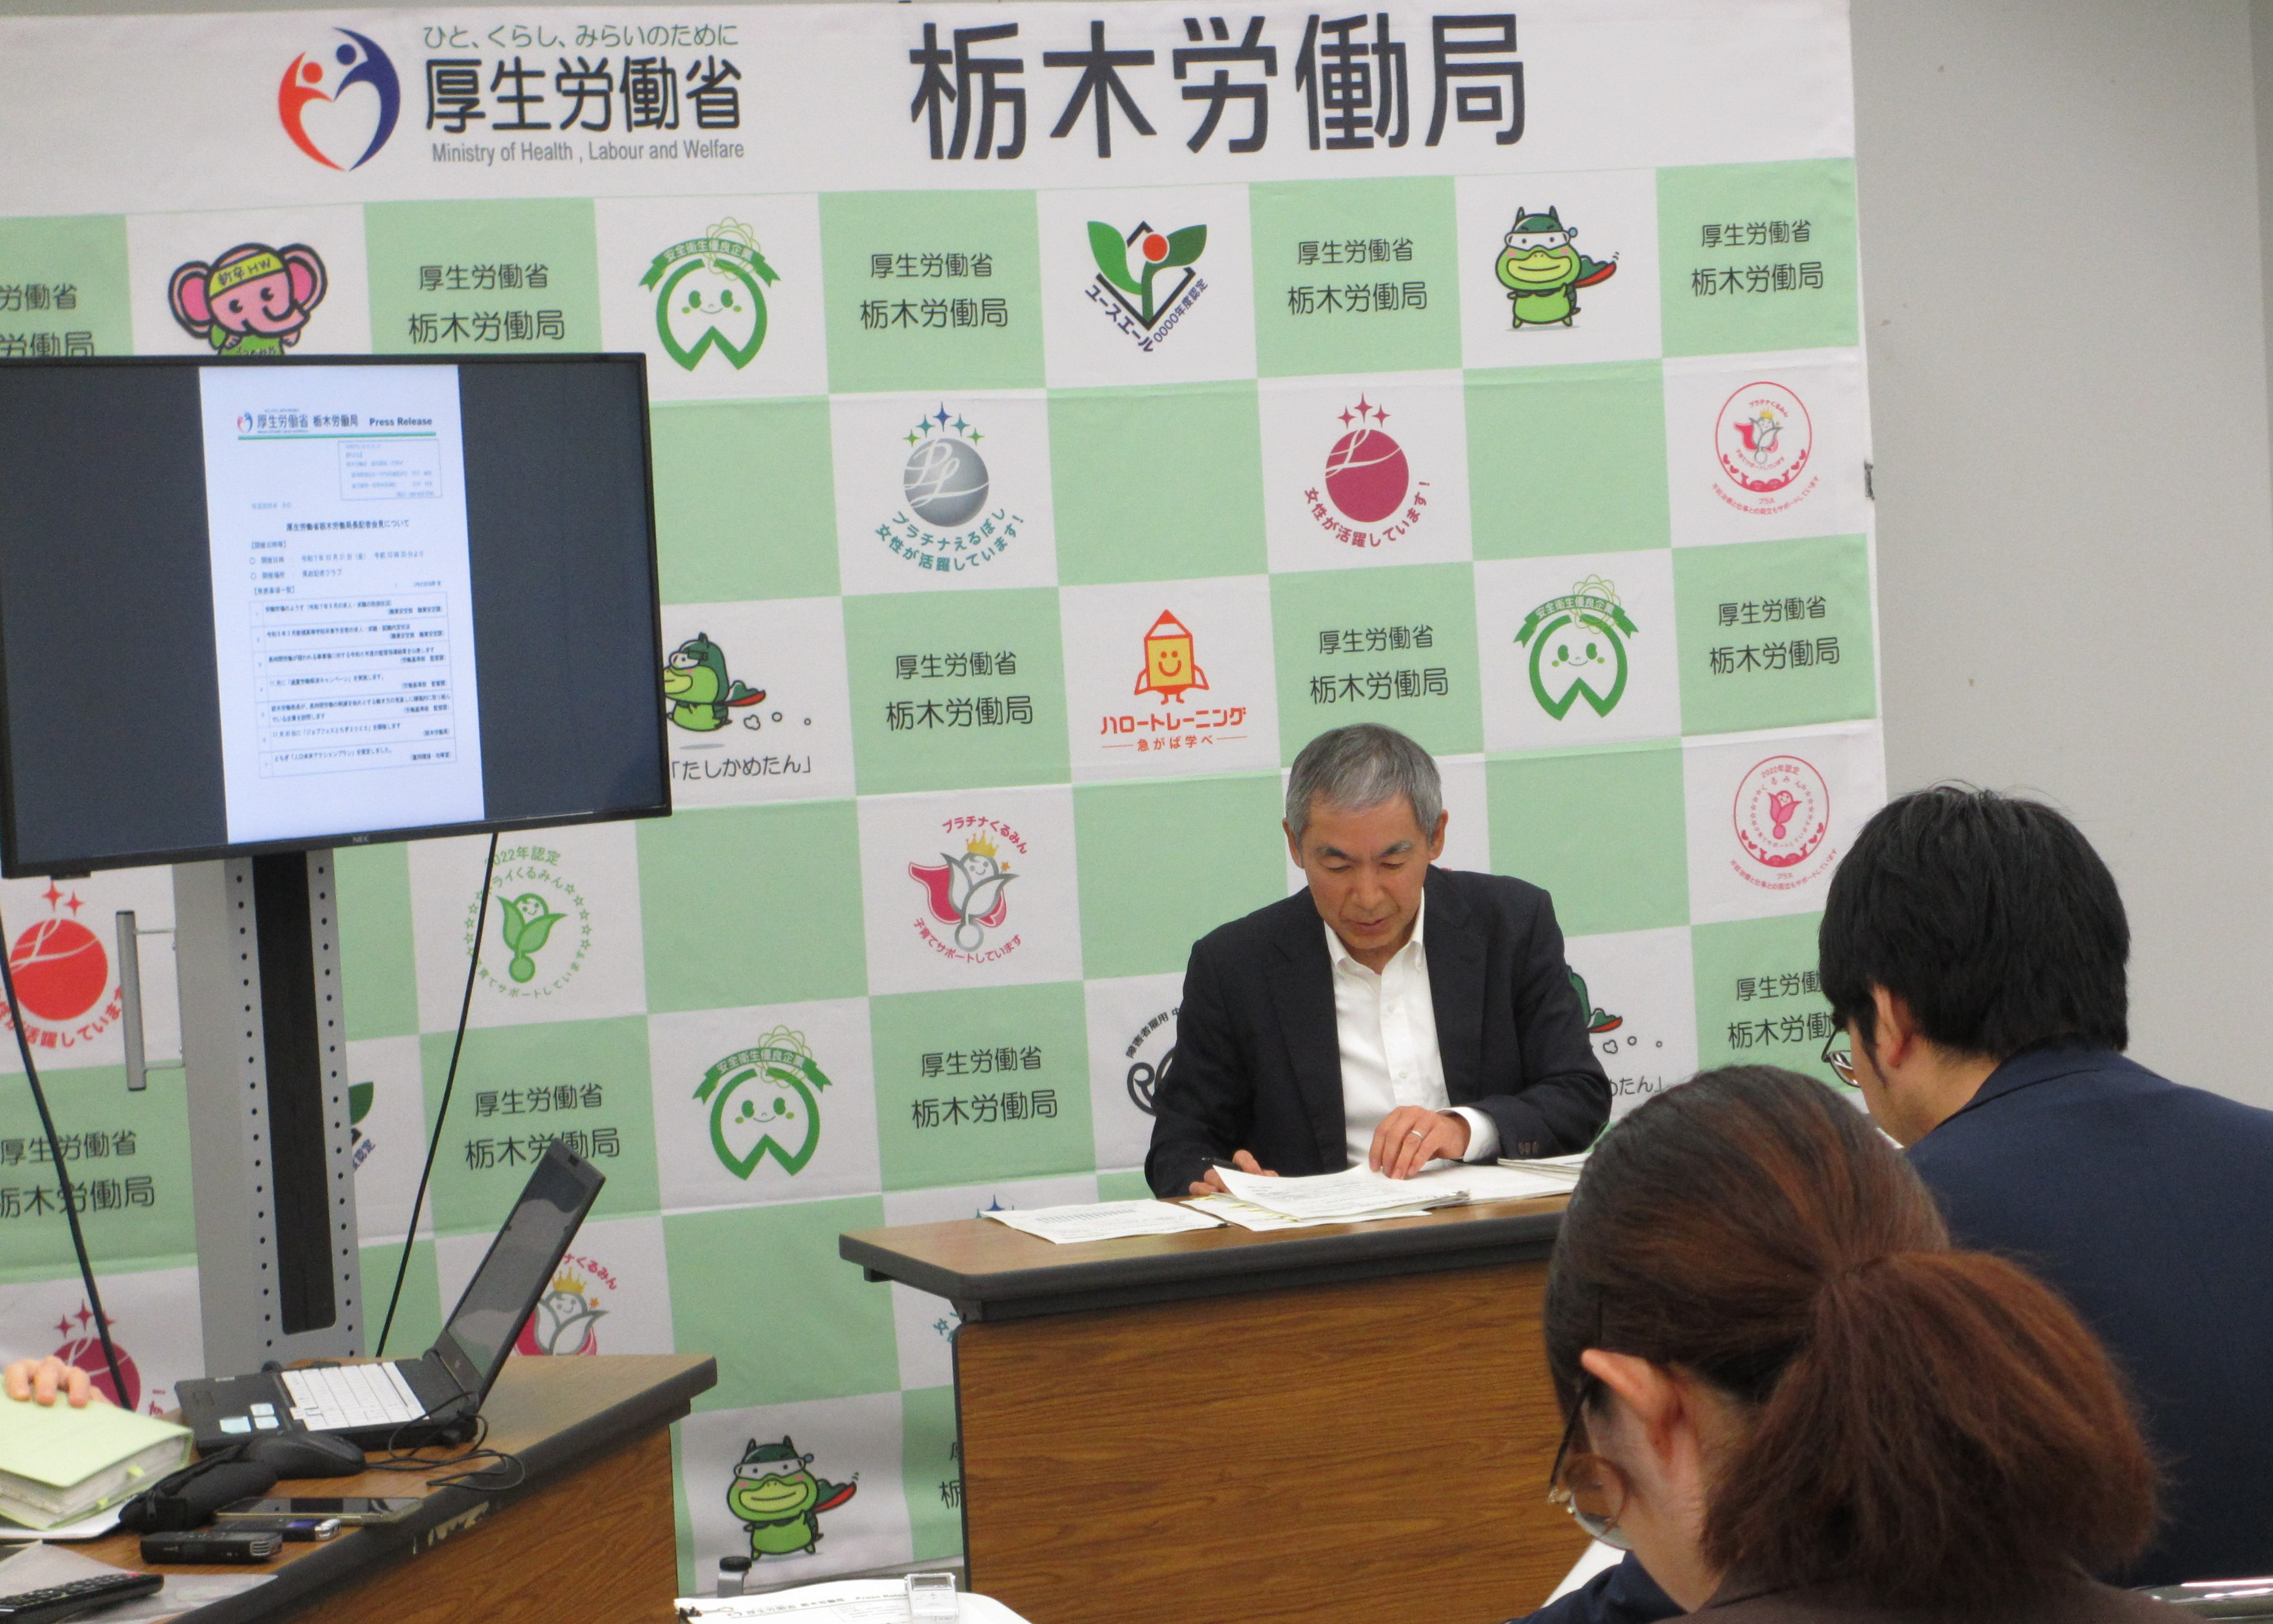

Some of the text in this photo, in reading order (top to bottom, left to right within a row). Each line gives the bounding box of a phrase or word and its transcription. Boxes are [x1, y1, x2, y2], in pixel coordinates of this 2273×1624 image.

[423, 24, 739, 49] ひと、くらし、みらいのために
[425, 56, 742, 134] 厚生労働省
[909, 12, 1525, 161] 栃木労働局
[432, 141, 495, 165] Ministry
[500, 141, 516, 162] of
[520, 141, 573, 162] Health
[588, 140, 644, 161] Labour
[649, 140, 678, 160] and
[683, 139, 744, 159] Welfare
[1701, 220, 1812, 248] 厚生労働省
[870, 253, 994, 280] 厚生労働省
[1297, 239, 1414, 266] 厚生労働省
[419, 264, 550, 291] 厚生労働省
[1691, 261, 1824, 297] 栃木労働局
[860, 298, 1009, 330] 栃木労働局
[1288, 282, 1427, 315] 栃木労働局
[408, 310, 564, 345] 栃木労働局
[1085, 284, 1154, 352] ユースエール
[257, 414, 308, 429] 厚生労働省
[369, 417, 395, 426] Press
[397, 417, 433, 426] Release
[892, 508, 1006, 552] プラチナえるぼし
[1718, 595, 1826, 627] 厚生労働省
[1319, 624, 1434, 656] 厚生労働省
[1709, 636, 1840, 675] 栃木労働局
[895, 651, 1017, 680] 厚生労働省
[1310, 667, 1448, 704] 栃木労働局
[886, 696, 1033, 731] 栃木労働局
[1101, 706, 1247, 736] ハロートレーニング
[1137, 734, 1215, 752] 急がば学べ
[671, 754, 812, 781] 「たしかめたん」
[353, 835, 370, 844] NEC
[943, 816, 1027, 855] プラチナくるみん
[488, 866, 563, 894] ライくるみん
[913, 917, 1022, 963] 子育てサポートしています
[921, 1046, 1042, 1078] 厚生労働省
[475, 1083, 603, 1118] 厚生労働省
[912, 1090, 1058, 1129] 栃木労働局
[0, 1129, 137, 1166] 厚生労働省
[465, 1127, 620, 1170] 栃木労働局
